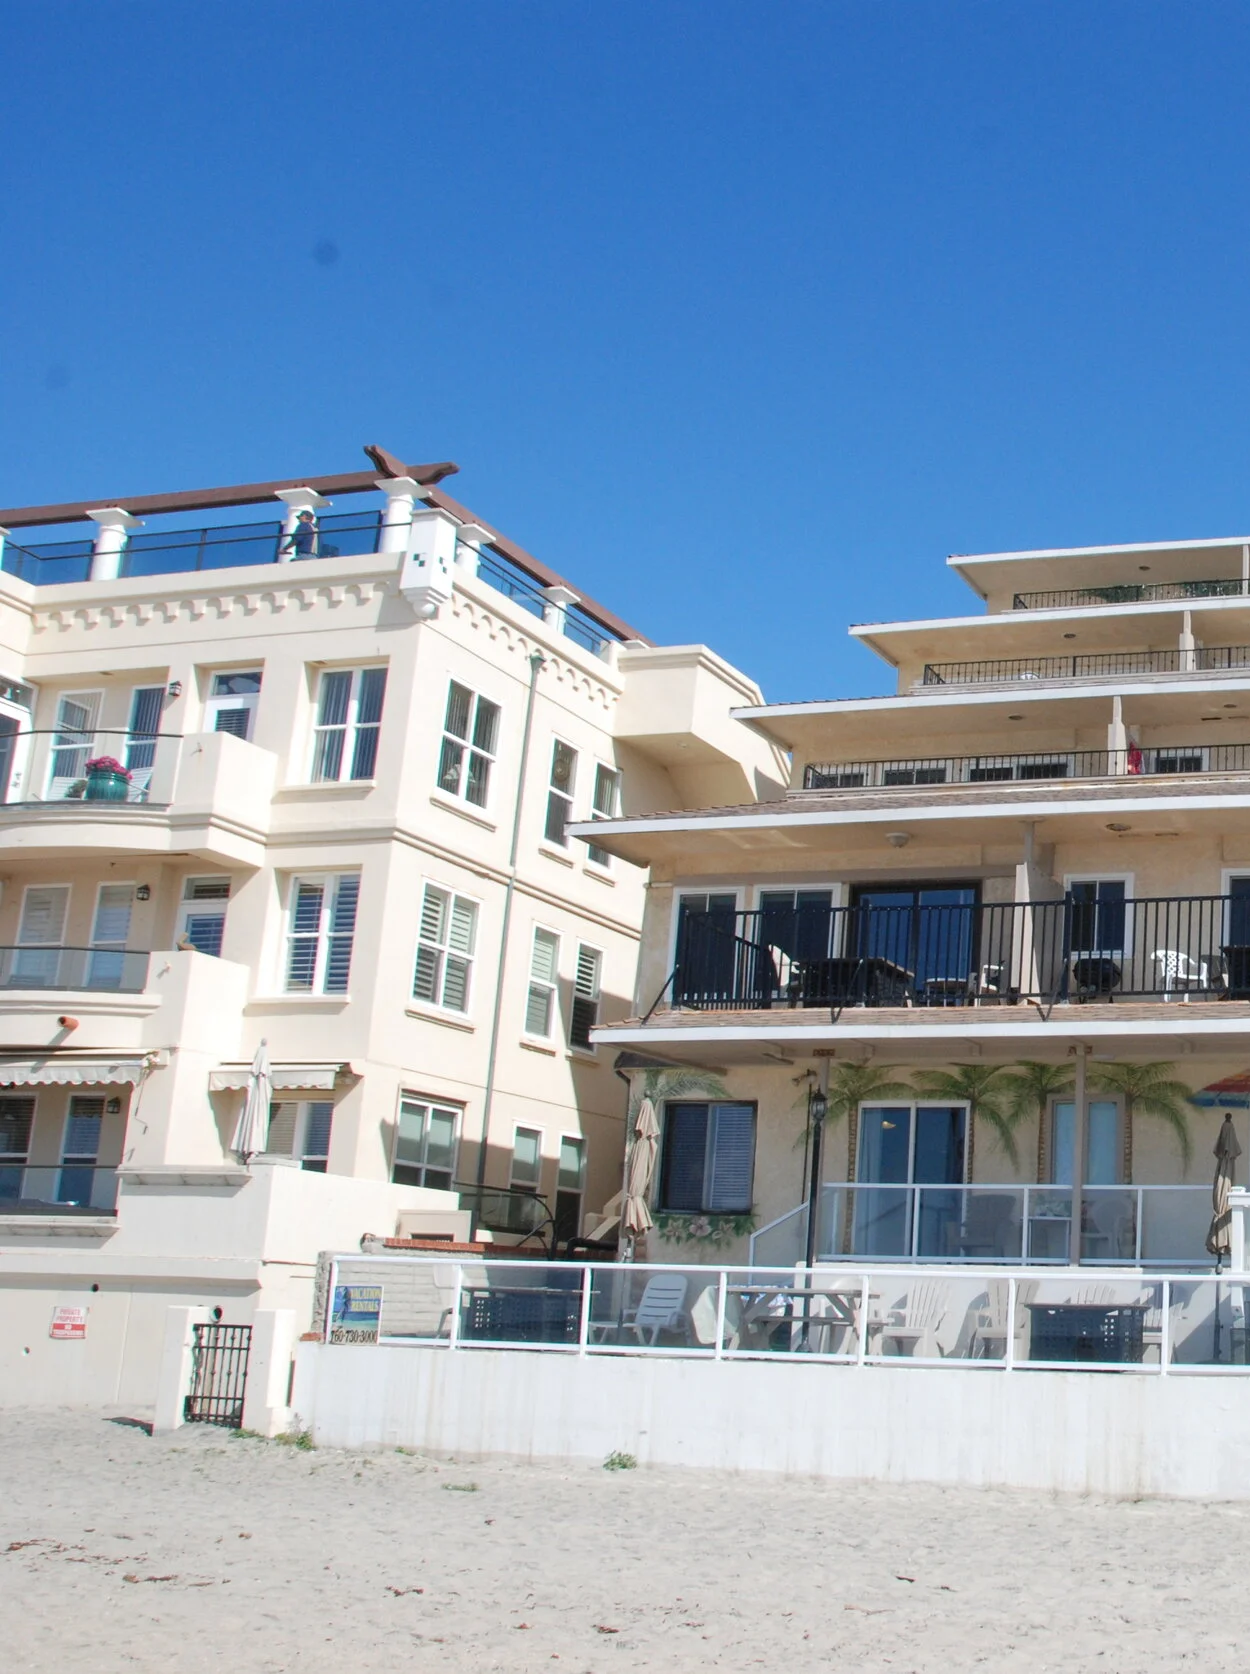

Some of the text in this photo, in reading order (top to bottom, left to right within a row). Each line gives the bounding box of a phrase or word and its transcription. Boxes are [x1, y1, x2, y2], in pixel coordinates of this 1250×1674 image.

[352, 1288, 381, 1299] VACATION
[352, 1302, 378, 1312] RENTALS
[331, 1329, 378, 1342] 760-730-3000
